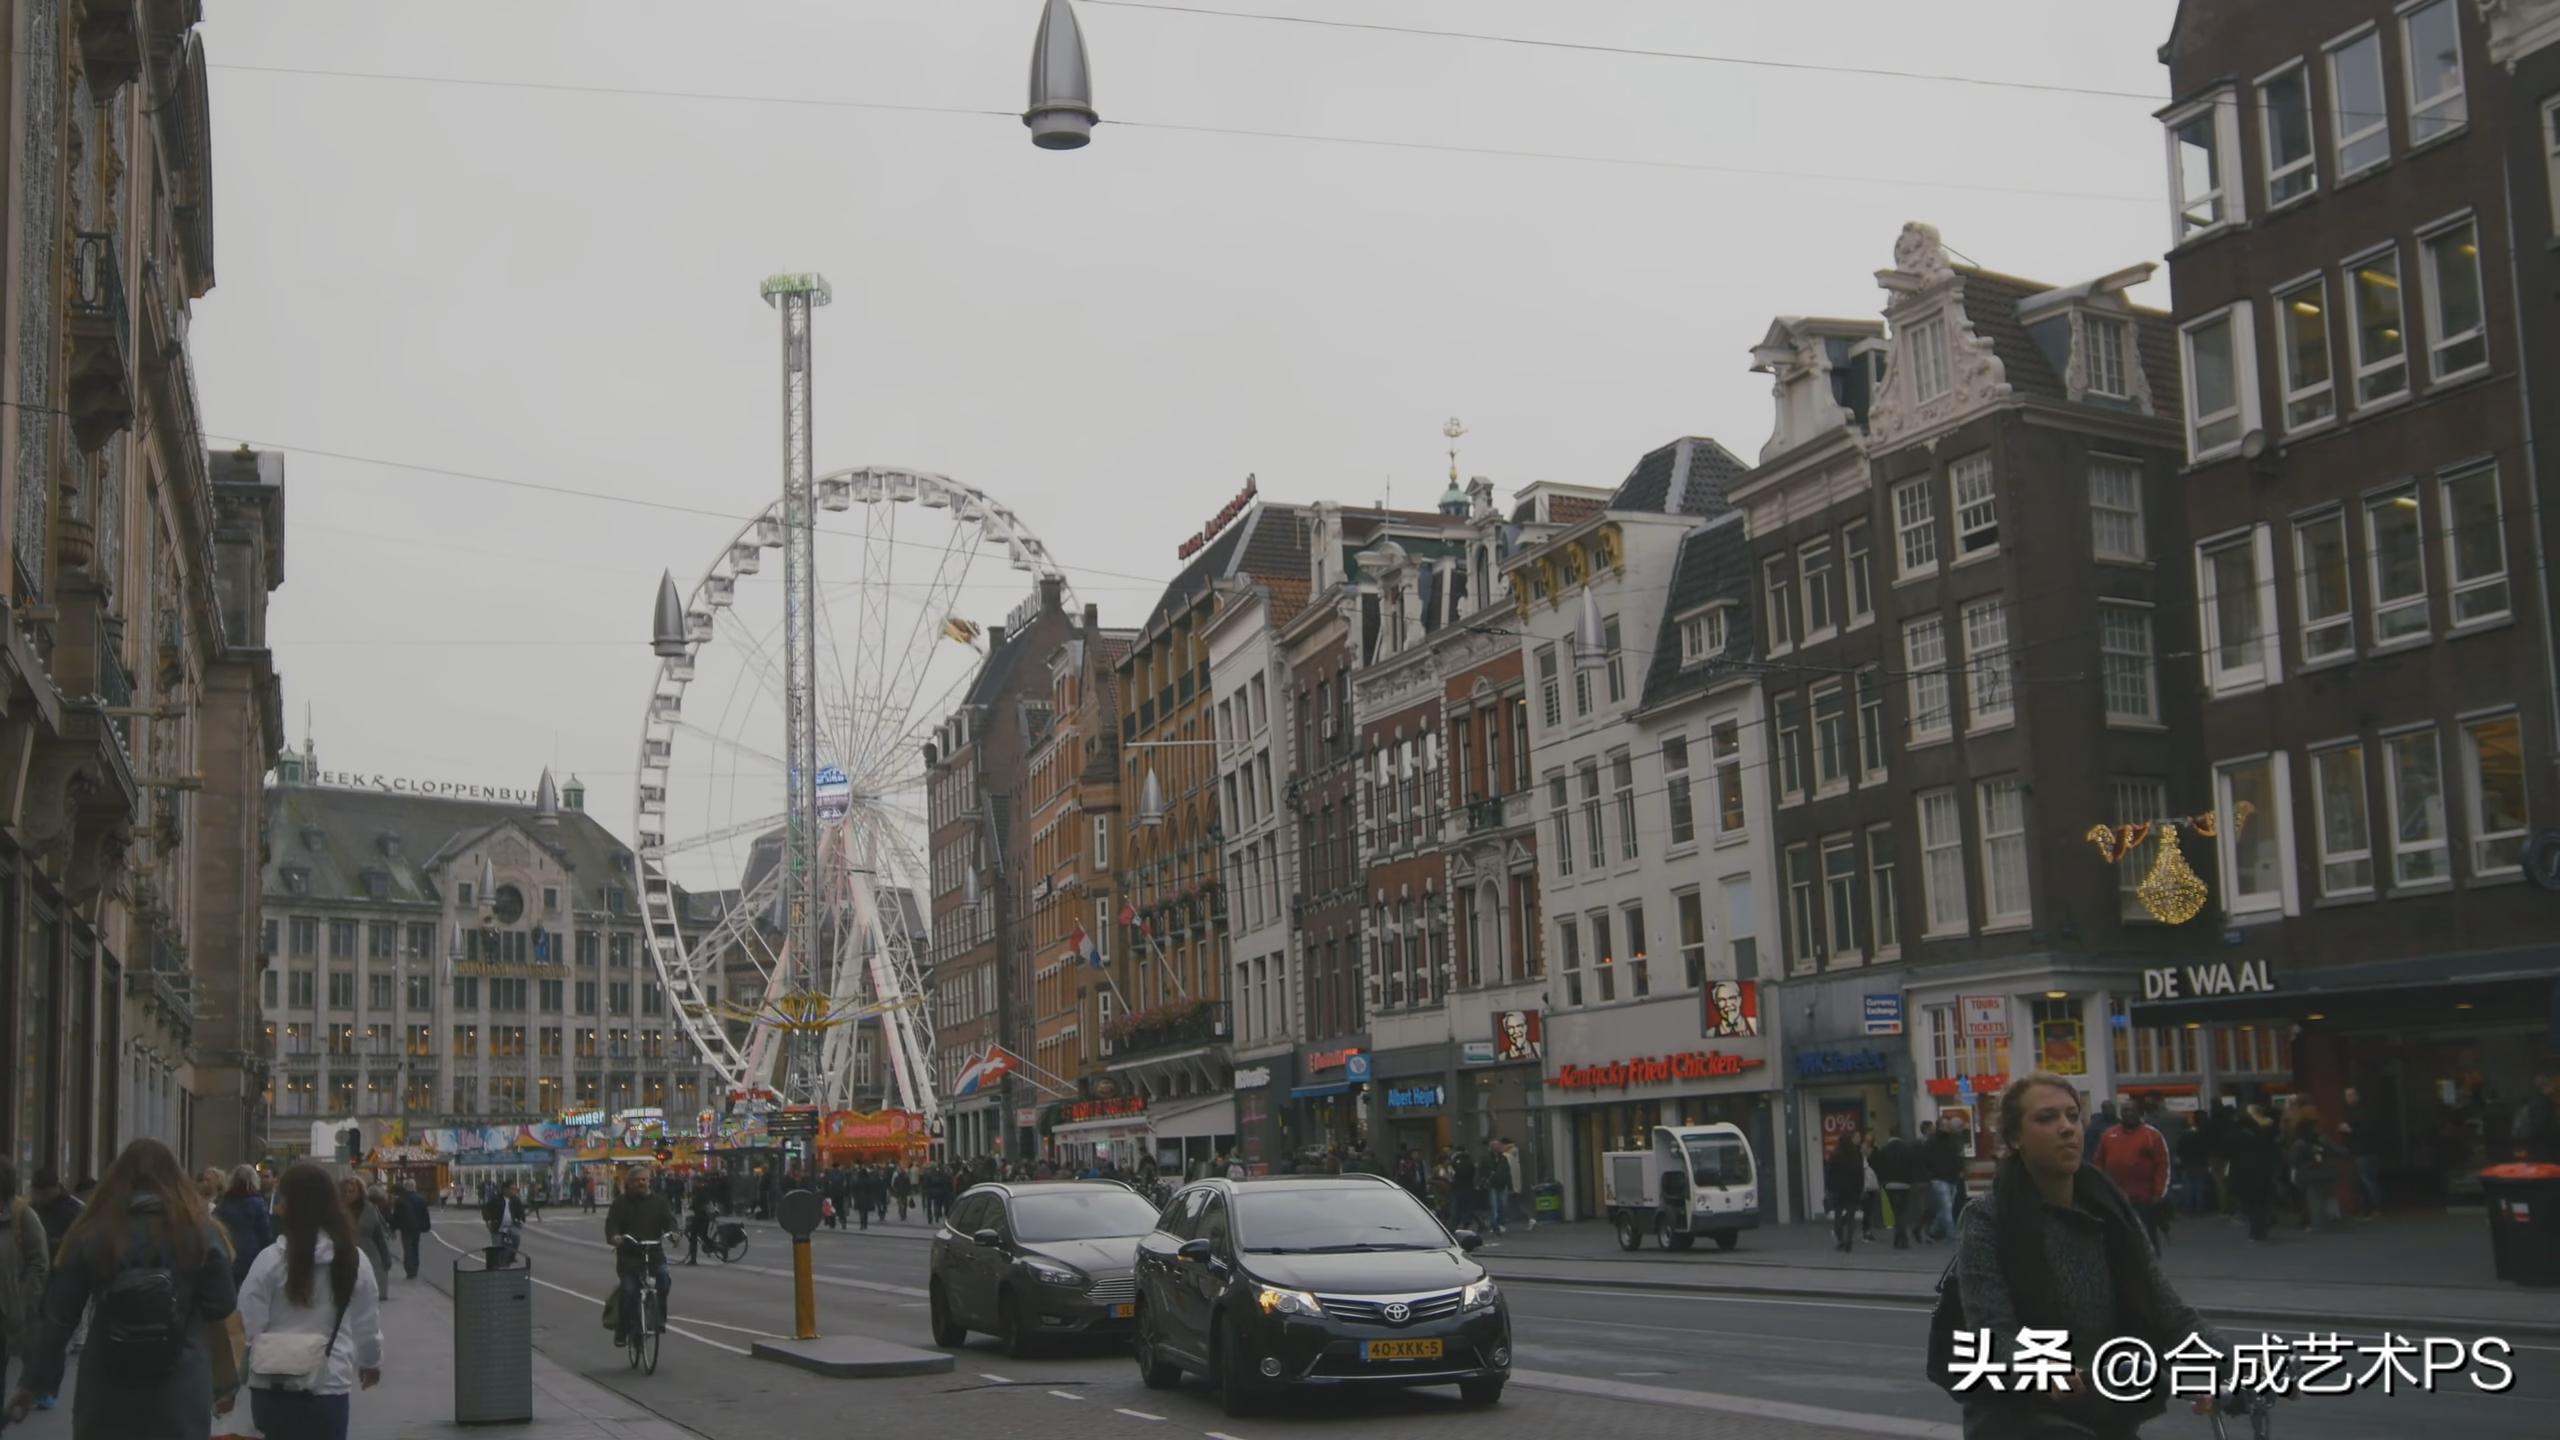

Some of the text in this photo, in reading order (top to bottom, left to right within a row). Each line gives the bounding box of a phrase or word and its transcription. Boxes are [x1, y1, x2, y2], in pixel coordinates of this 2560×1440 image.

[393, 778, 560, 802] CLOPPENBU
[2144, 959, 2275, 999] DE WAAL
[1971, 999, 2001, 1010] TOURS
[1968, 1023, 2007, 1033] TICKETS
[1559, 1064, 1628, 1090] Kentucky
[1629, 1057, 1671, 1083] Fried
[1371, 1341, 1439, 1356] 40-XKK-5
